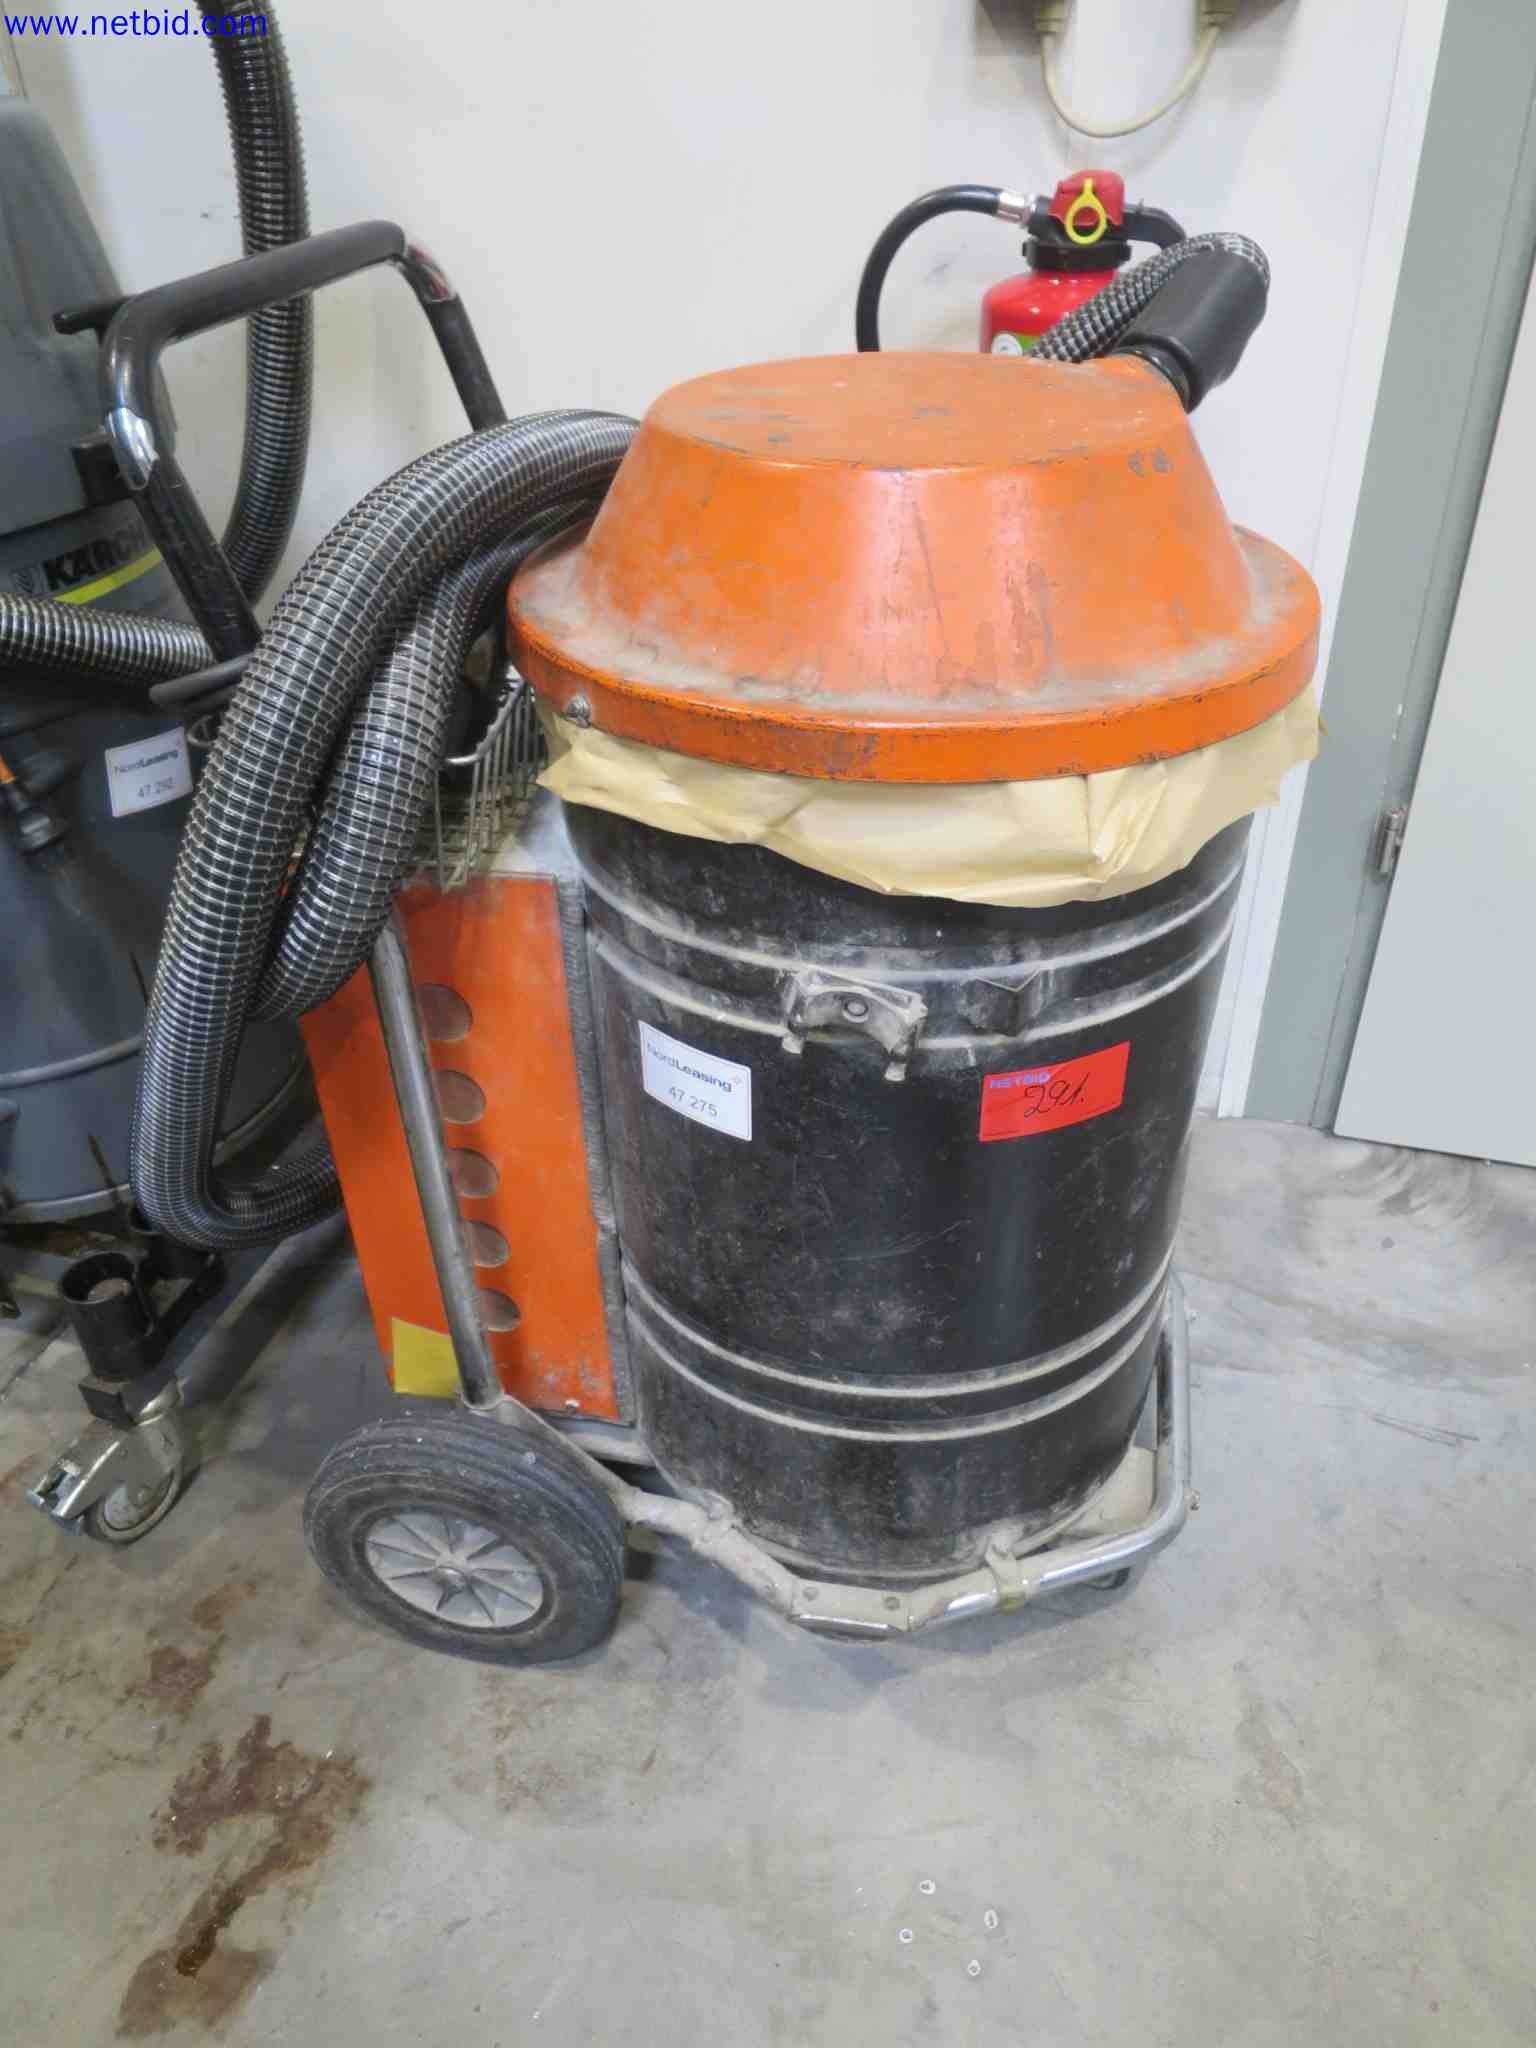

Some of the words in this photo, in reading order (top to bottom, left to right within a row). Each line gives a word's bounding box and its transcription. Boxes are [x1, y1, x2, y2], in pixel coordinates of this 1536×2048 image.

[646, 1041, 732, 1093] NordLeasing
[669, 1085, 686, 1102] 47
[689, 1095, 718, 1118] 275
